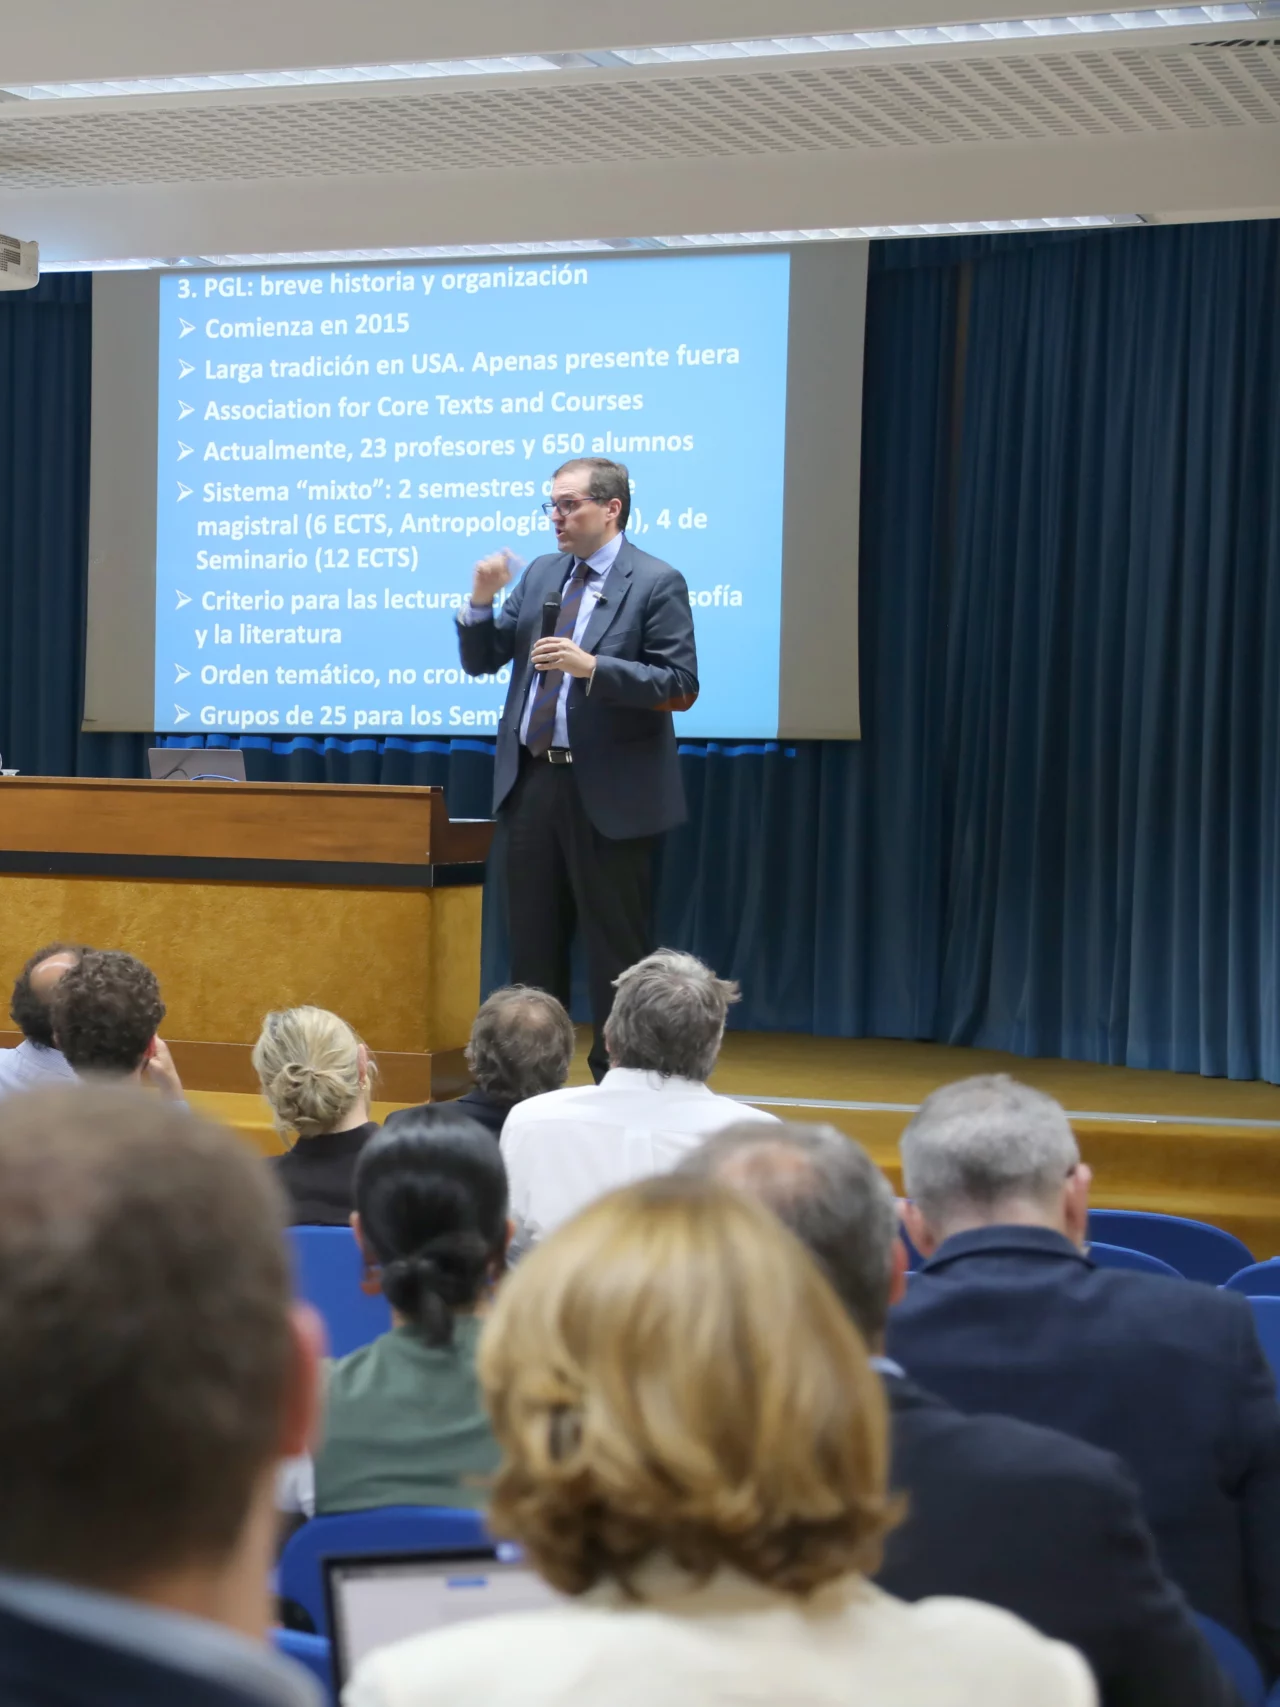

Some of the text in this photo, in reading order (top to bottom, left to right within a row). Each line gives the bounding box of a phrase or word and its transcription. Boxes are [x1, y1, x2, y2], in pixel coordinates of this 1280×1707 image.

[177, 263, 588, 299] 3. PGL: breve historia y organización
[205, 312, 410, 339] Comienza en 2015
[205, 343, 740, 384] Larga tradición en USA. Apenas presente fuera
[203, 391, 644, 421] Association for Core Texts and Courses
[203, 431, 694, 462] Actualmente, 23 profesores y 650 alumnos
[203, 481, 289, 503] Sistema
[296, 478, 391, 500] “mixto”:
[398, 479, 411, 499] 2
[418, 478, 535, 499] semestres
[197, 513, 298, 541] magistral
[305, 513, 327, 539] (6
[334, 513, 393, 537] ECTS,
[399, 510, 550, 537] Antropología
[656, 509, 672, 529] 4
[678, 507, 708, 529] de
[196, 545, 419, 573] Seminario (12 ECTS)
[201, 589, 284, 611] Criterio
[291, 594, 340, 615] para
[347, 588, 378, 609] las
[194, 623, 342, 649] y la literatura
[200, 663, 269, 685] Orden
[275, 663, 381, 688] temático,
[388, 668, 417, 685] no
[200, 705, 280, 730] Grupos
[285, 704, 314, 726] de
[319, 705, 347, 726] 25
[353, 710, 403, 730] para
[410, 704, 443, 726] los
